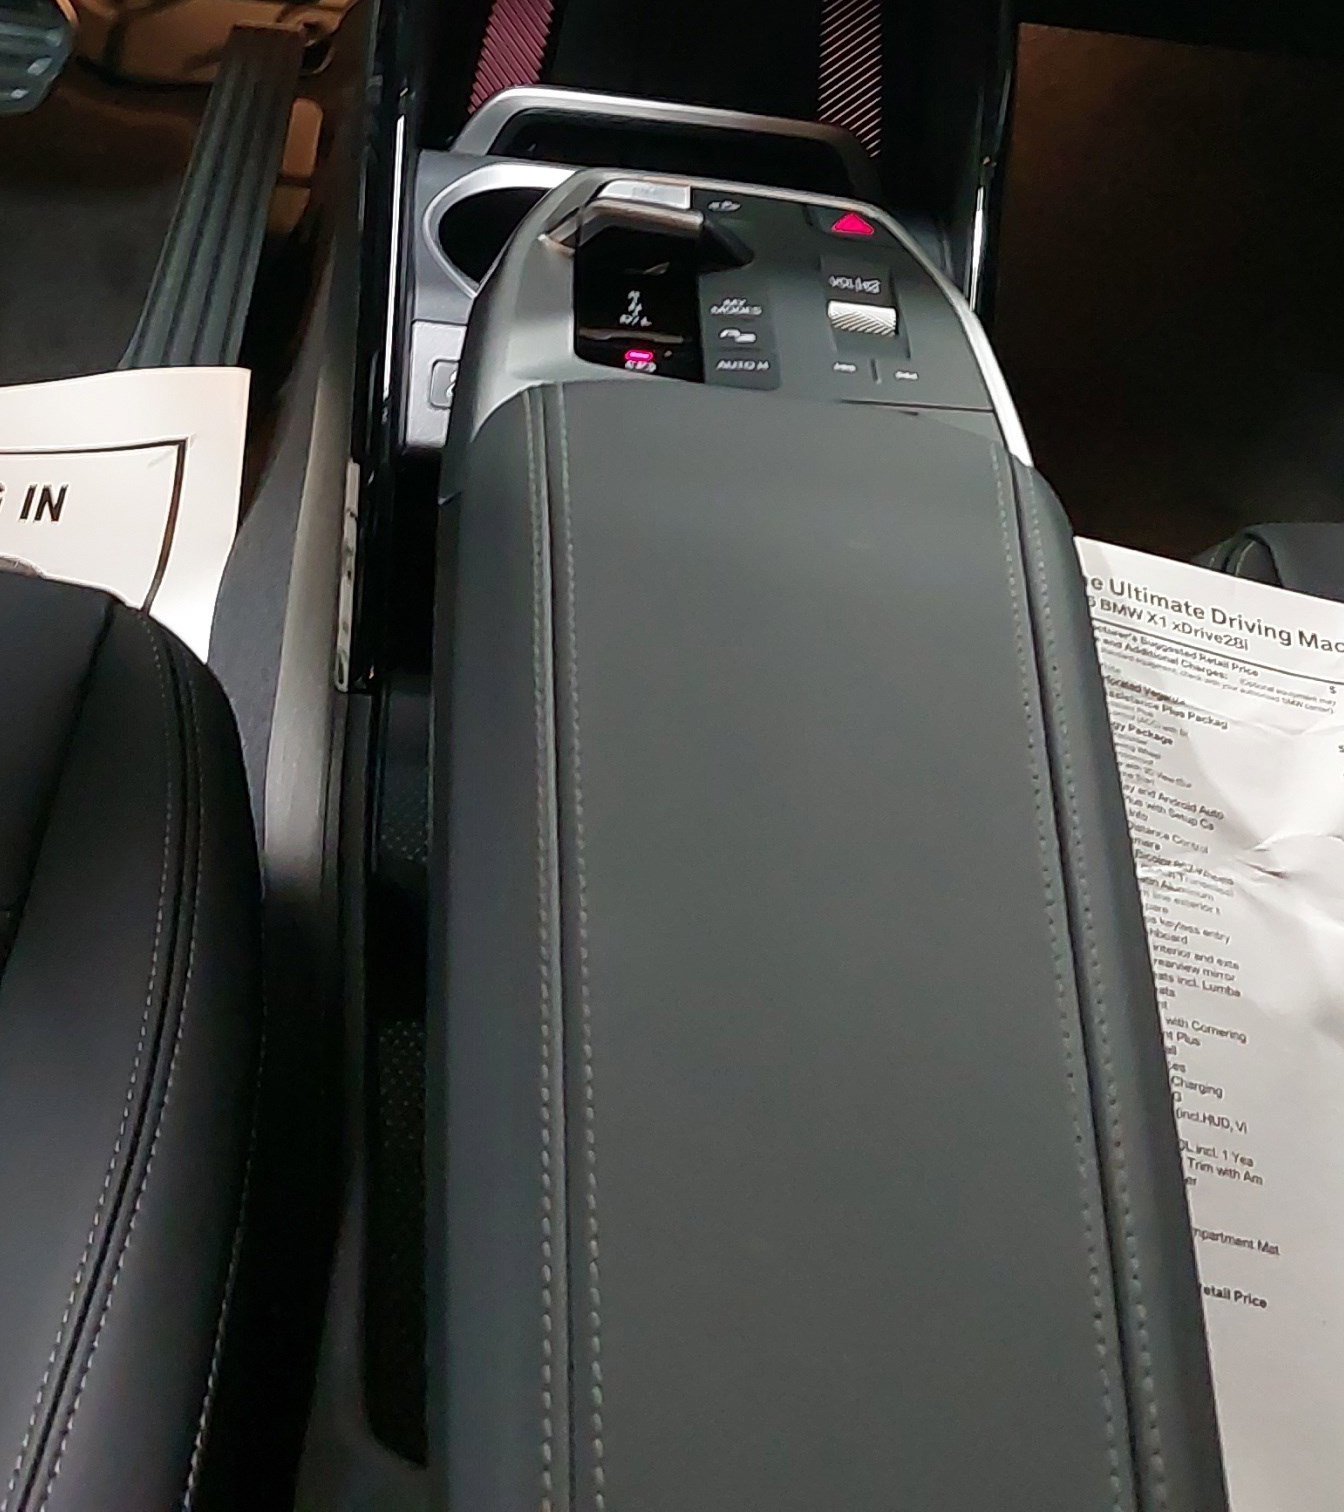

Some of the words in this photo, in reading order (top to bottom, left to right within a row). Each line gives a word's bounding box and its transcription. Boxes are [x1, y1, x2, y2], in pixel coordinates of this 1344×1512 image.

[19, 483, 68, 523] IN
[1100, 601, 1143, 620] BMW
[1147, 611, 1166, 628] X1
[1109, 577, 1205, 620] Ultimate
[1211, 606, 1291, 646] Driving
[1231, 662, 1259, 676] Price
[1234, 1289, 1267, 1309] Price
